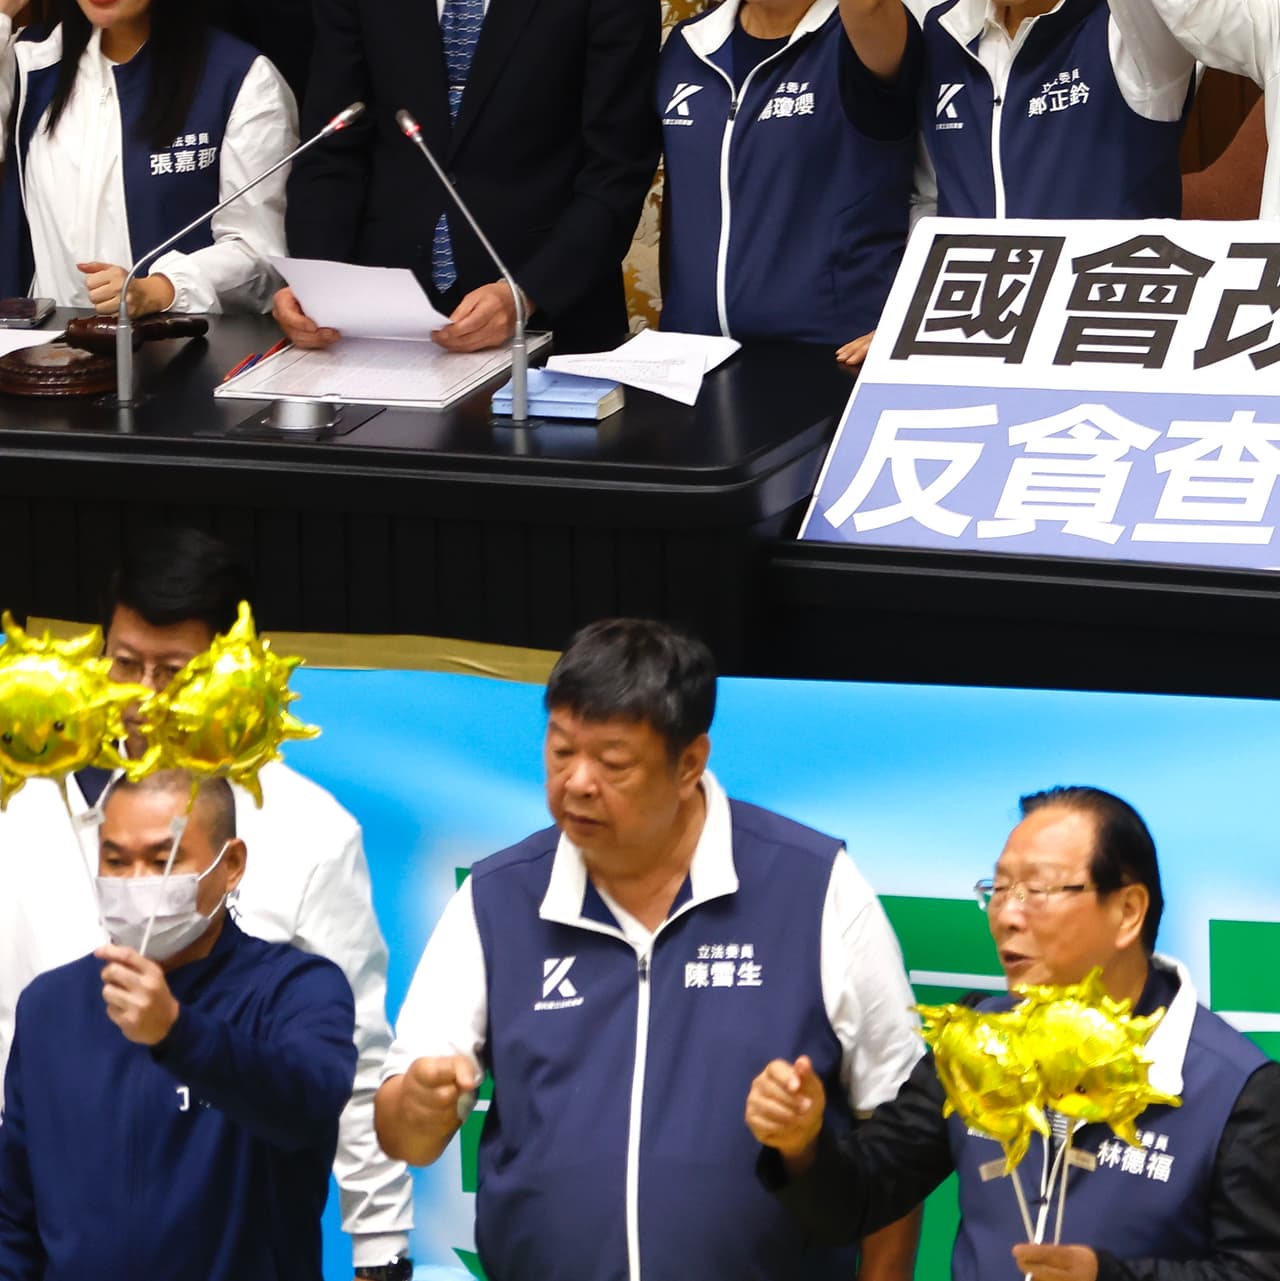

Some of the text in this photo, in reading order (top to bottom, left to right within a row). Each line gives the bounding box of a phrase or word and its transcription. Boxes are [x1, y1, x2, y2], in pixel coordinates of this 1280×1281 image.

[1028, 82, 1090, 118] 鄭正鈐
[149, 146, 218, 176] 張嘉郡
[697, 943, 754, 960] 立法委員
[685, 960, 763, 989] 陳雪生
[1097, 1139, 1176, 1183] 林德福
